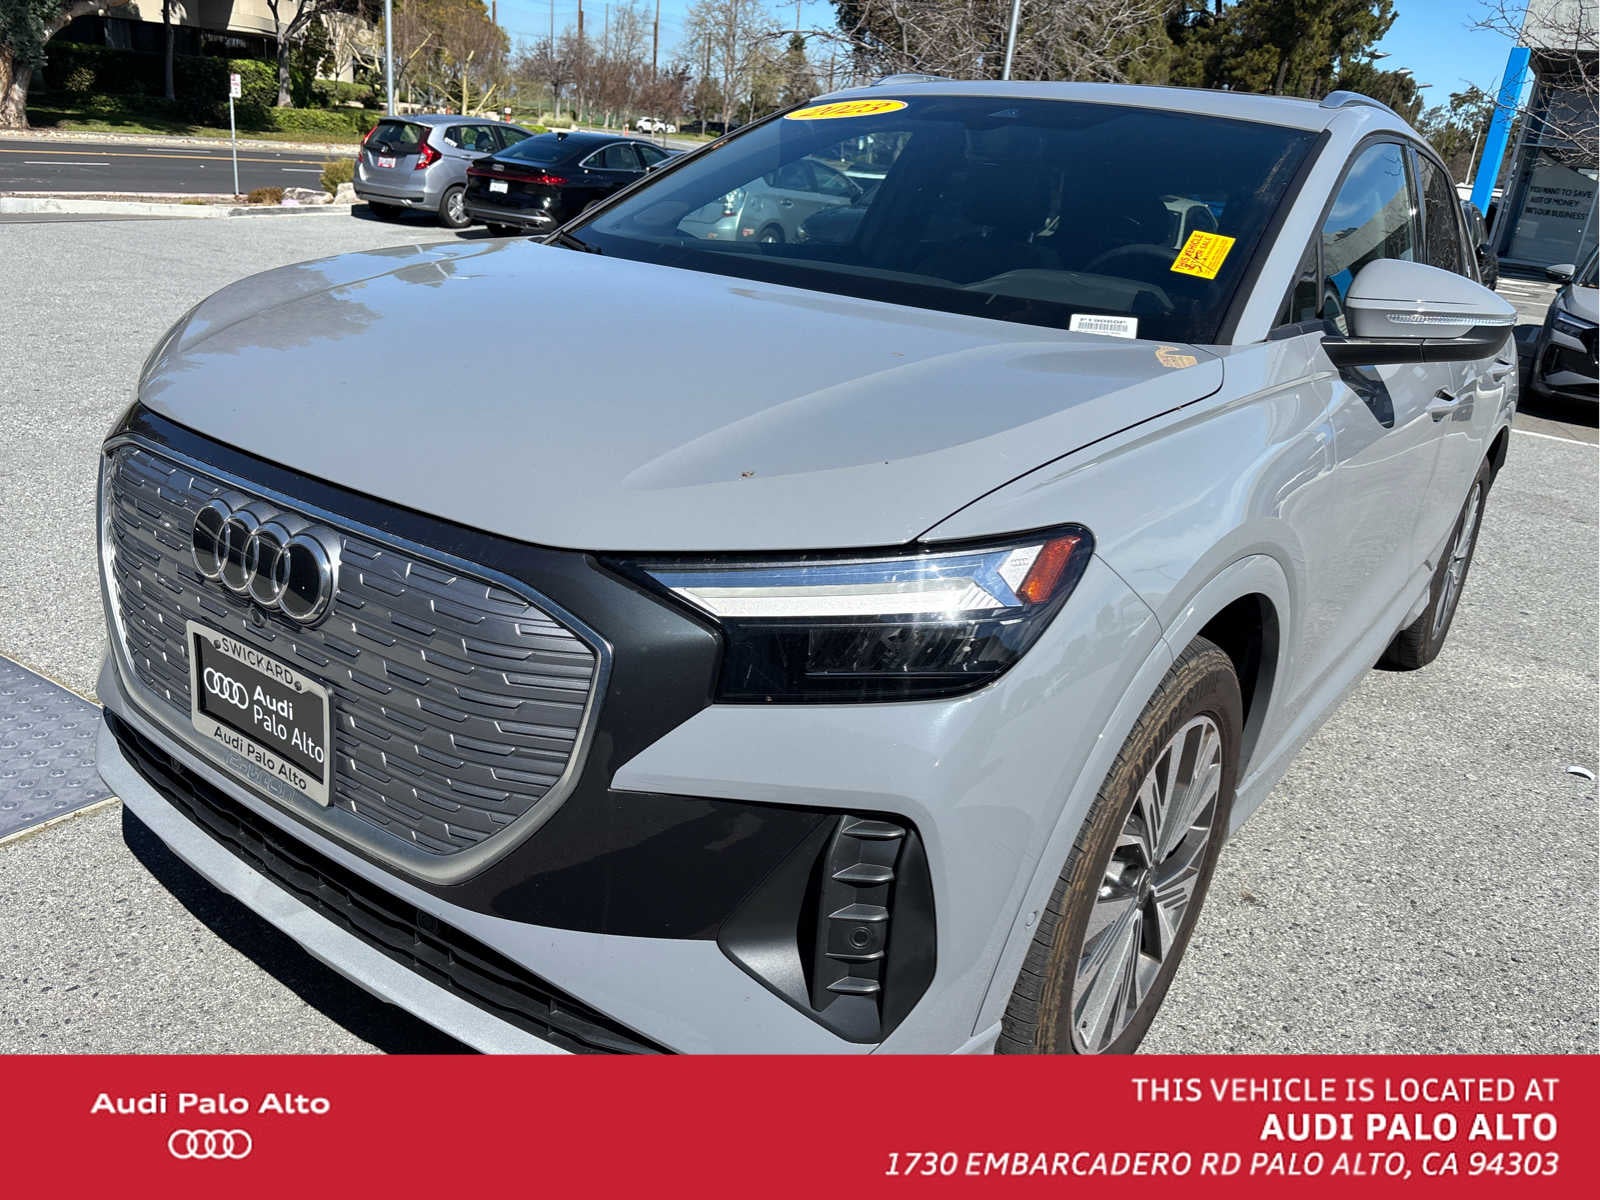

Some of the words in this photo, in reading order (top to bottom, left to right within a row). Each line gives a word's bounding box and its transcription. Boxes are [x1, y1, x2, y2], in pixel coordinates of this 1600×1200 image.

[222, 637, 294, 685] SWICKARD
[253, 685, 293, 721] Audi
[214, 726, 243, 750] Audi
[247, 744, 275, 771] Palo
[278, 764, 307, 790] Alto
[253, 704, 287, 740] Palo
[291, 727, 324, 763] Alto
